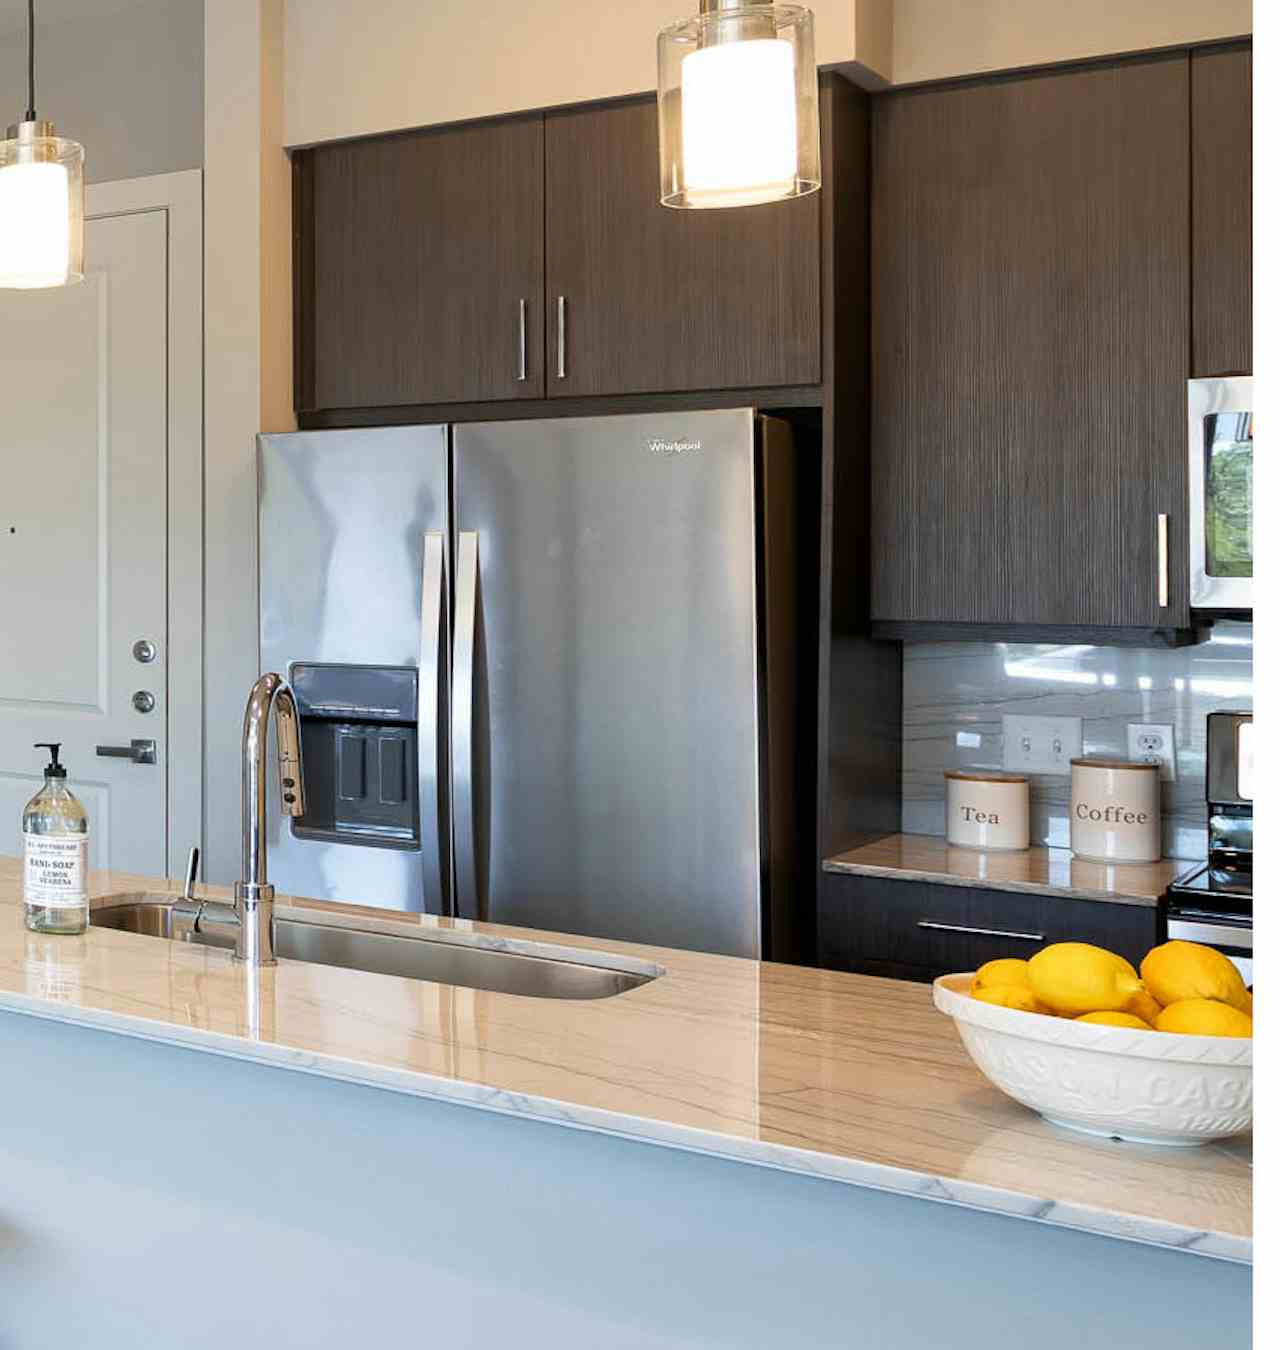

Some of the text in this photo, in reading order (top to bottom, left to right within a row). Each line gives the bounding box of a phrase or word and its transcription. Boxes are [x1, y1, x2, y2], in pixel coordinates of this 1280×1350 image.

[648, 440, 702, 453] Whirlpool
[960, 805, 1001, 825] Tea
[1075, 803, 1148, 825] Coffee
